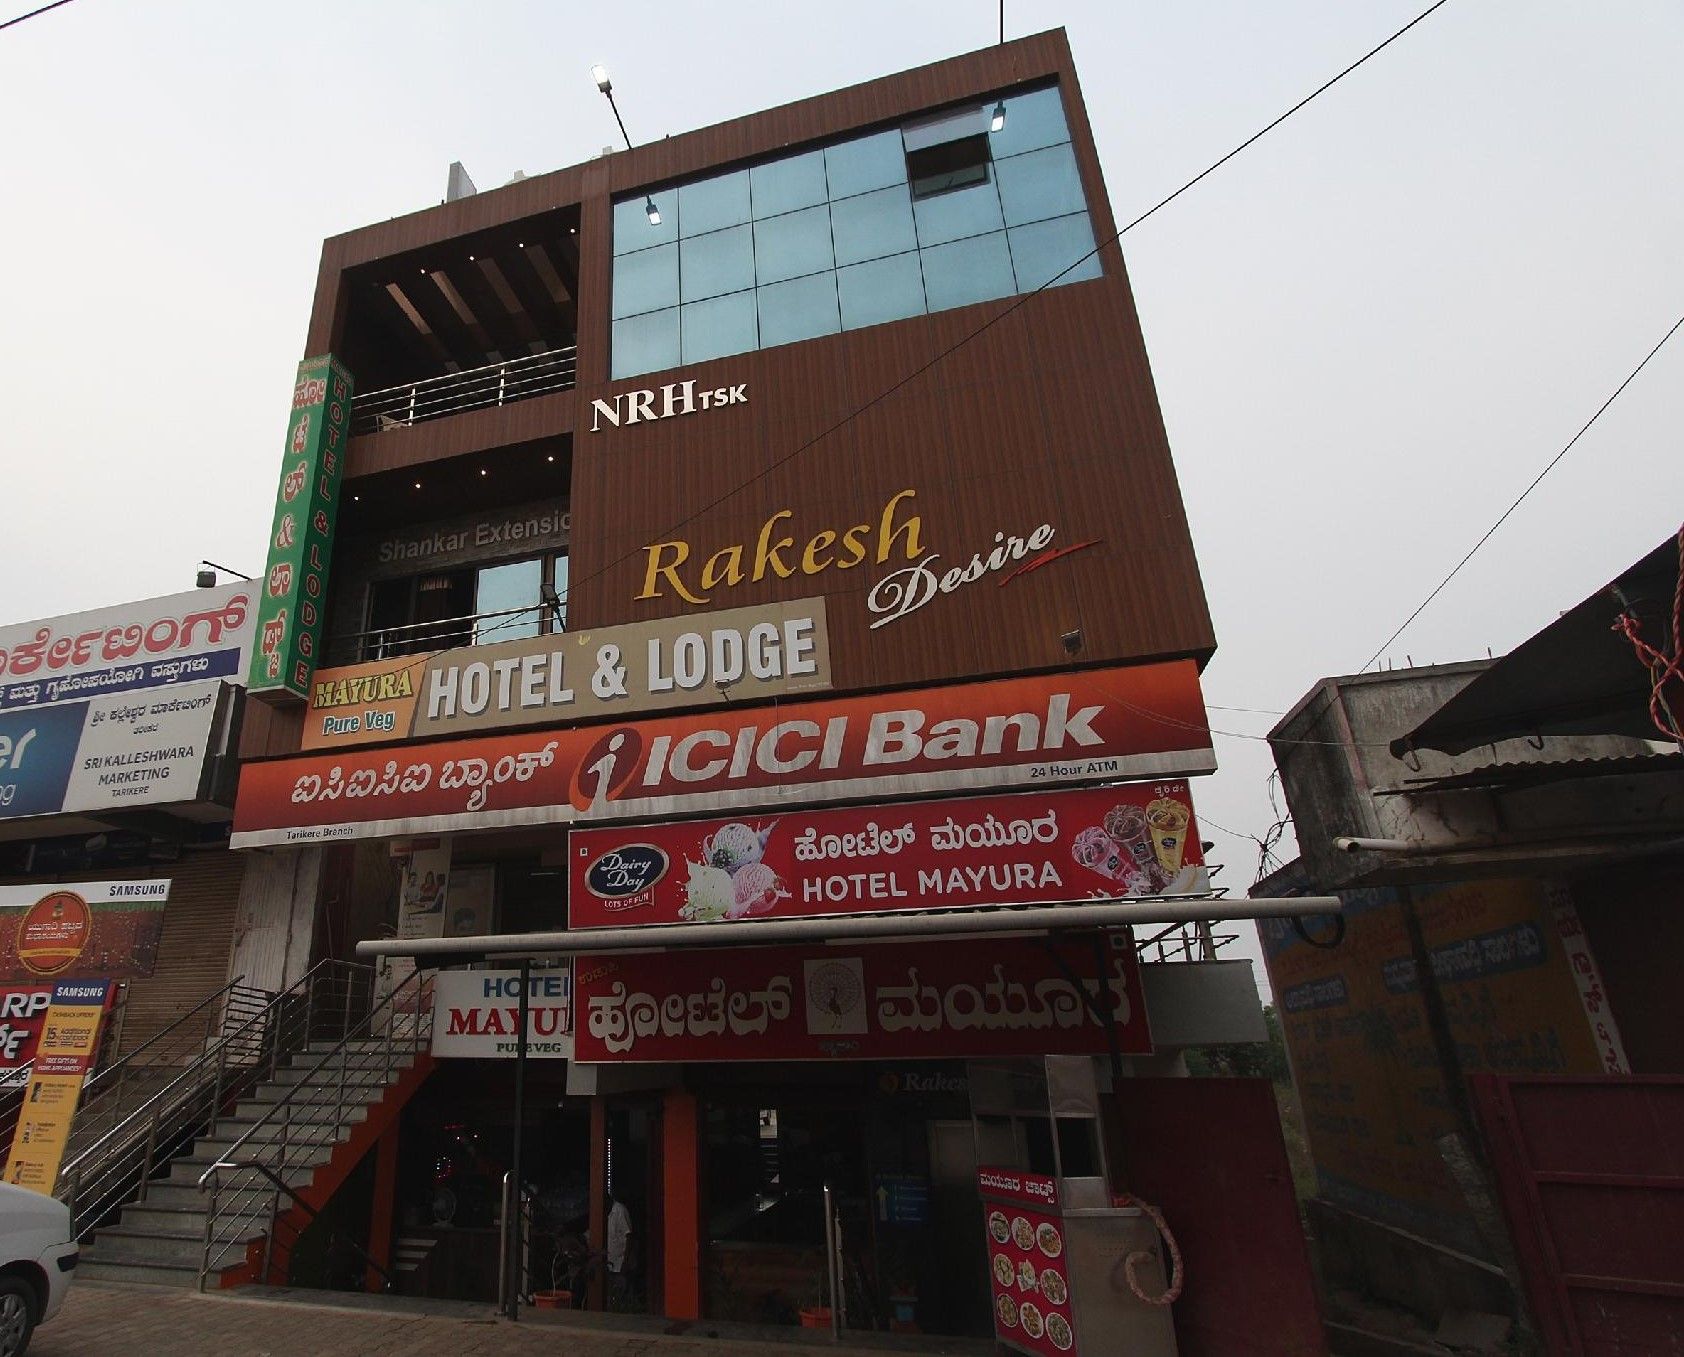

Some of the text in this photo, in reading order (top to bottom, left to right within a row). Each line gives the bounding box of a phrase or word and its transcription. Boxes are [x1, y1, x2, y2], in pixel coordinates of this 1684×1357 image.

[590, 379, 748, 433] NRH TSK
[319, 377, 346, 502] HOTEL
[314, 510, 328, 537] &
[378, 530, 469, 562] Shankar
[633, 489, 927, 605] Rakesh
[867, 521, 1056, 630] Desire
[295, 544, 321, 688] LODGE
[0, 594, 248, 676] ರ್ಕೇಟಿಂಗ್
[427, 618, 817, 719] HOTEL & LODGE
[313, 670, 413, 708] MAYURA
[322, 711, 395, 735] Pure Veg
[642, 693, 1106, 787] ICICI Bank
[84, 745, 194, 770] SRI KALLESHWARA
[1031, 759, 1118, 778] 24 Hour ATM
[98, 766, 170, 786] MARKETING
[291, 741, 558, 811] ಐಸಿಐಸಿಐ ಬ್ಯಾಂಕ್
[112, 785, 150, 797] TARIKERE
[286, 826, 353, 840] Tarikere Branch
[794, 808, 1059, 861] ಹೋಟೆಲ್ ಮಯೂರ
[600, 853, 652, 875] Dairy
[109, 884, 165, 897] SAMSUNG
[606, 869, 645, 892] Day
[803, 860, 1063, 903] HOTEL MAYURA
[604, 892, 649, 908] LOTS OF FUN
[56, 986, 104, 997] SAMSUNG
[496, 1042, 561, 1053] PUE VEG
